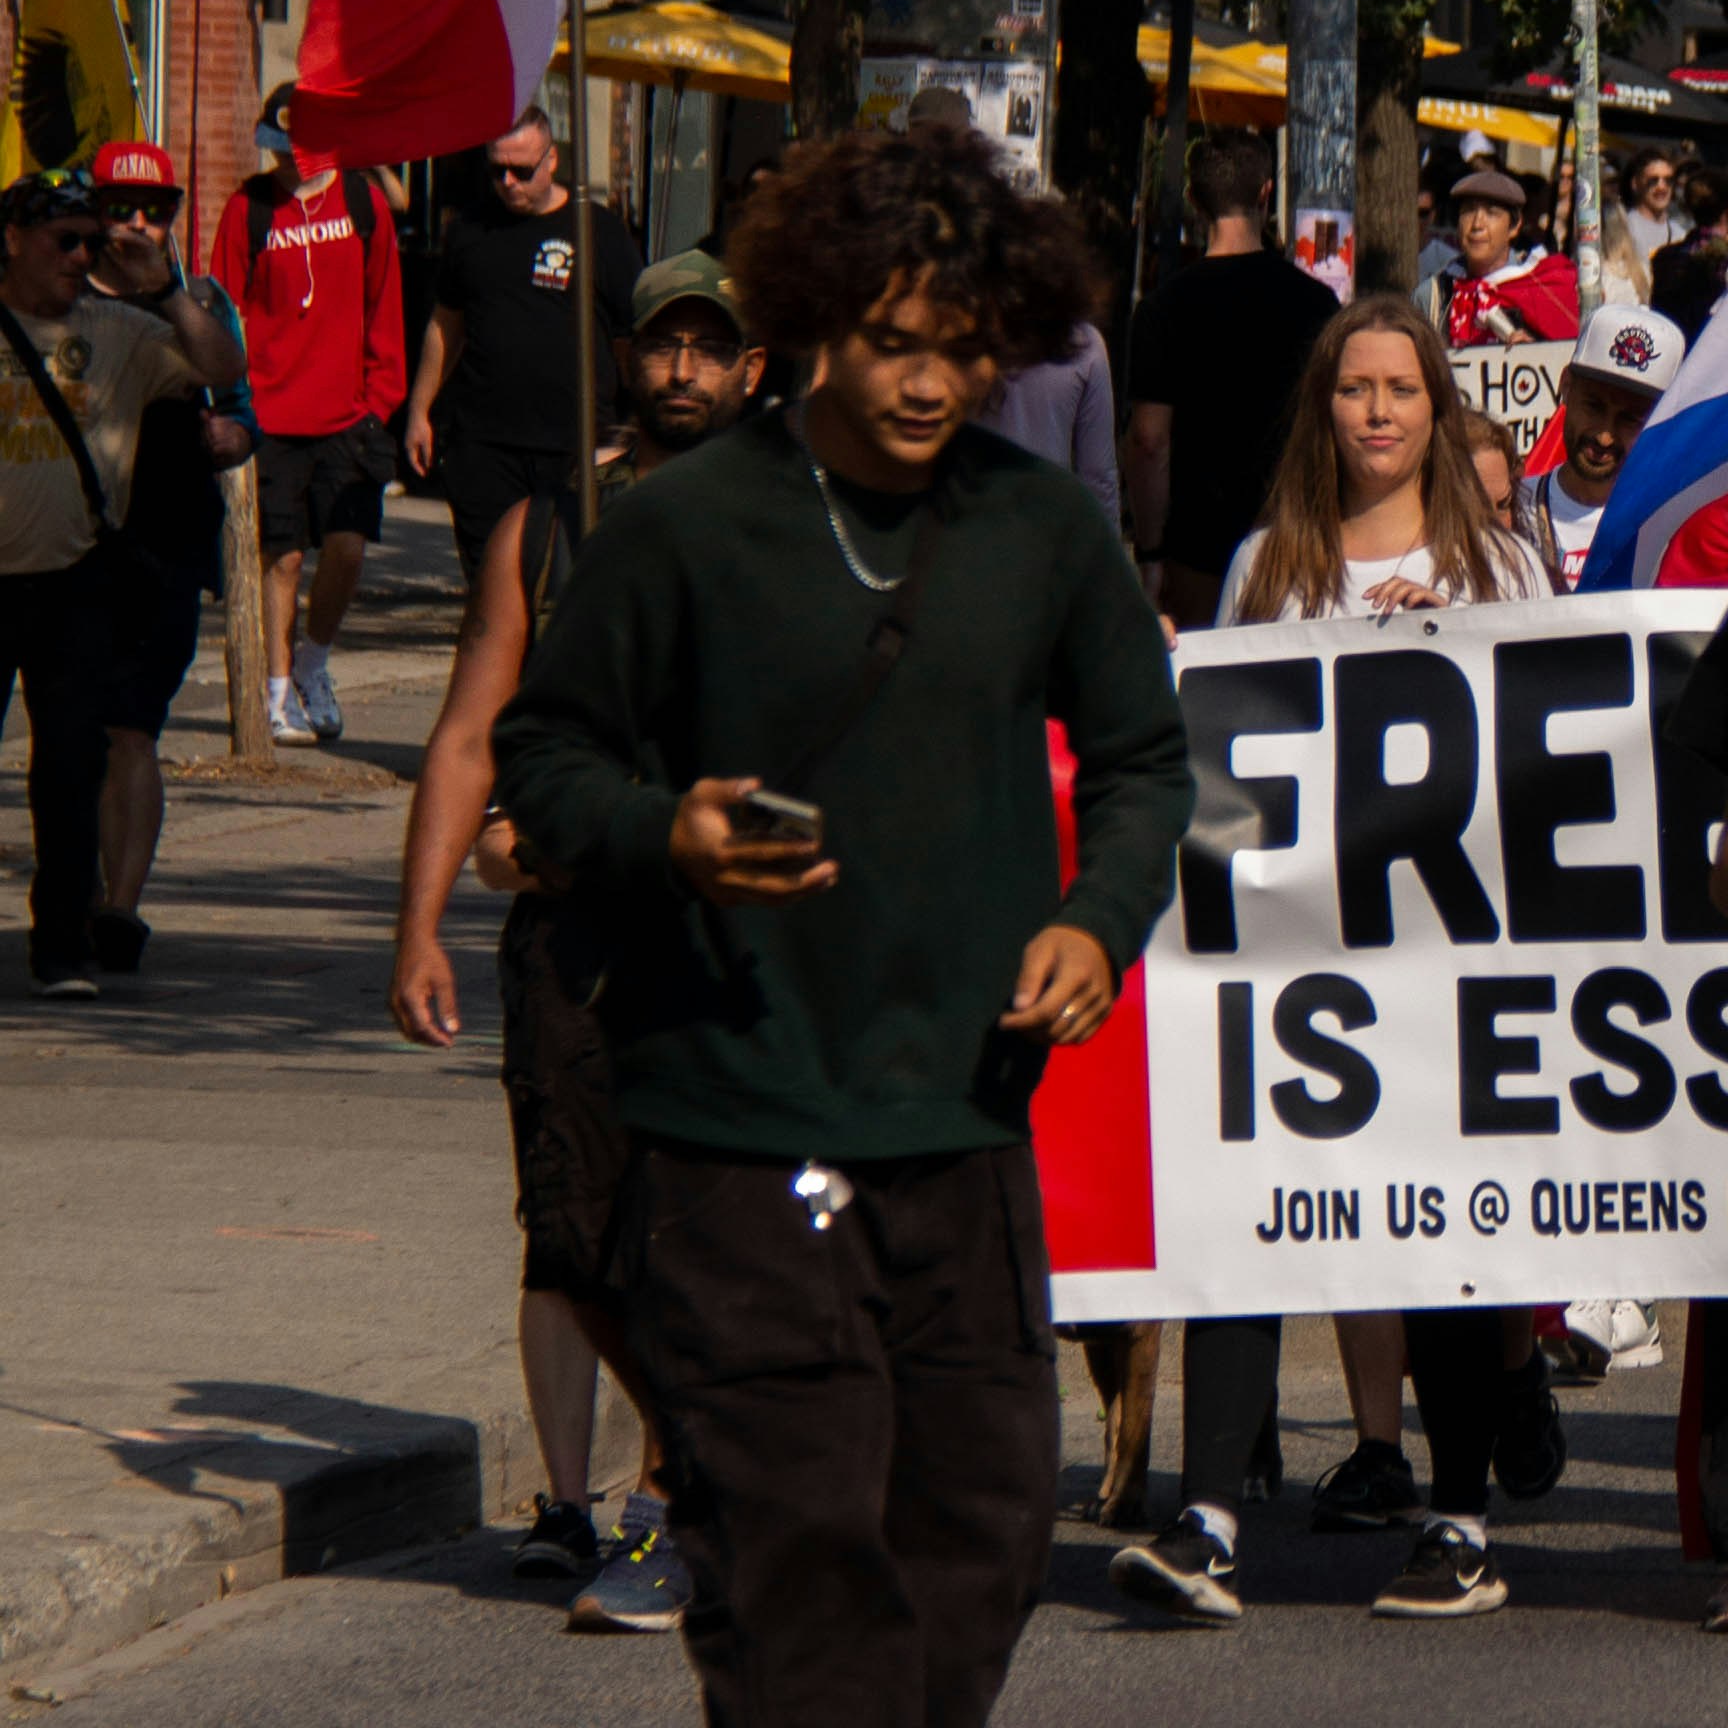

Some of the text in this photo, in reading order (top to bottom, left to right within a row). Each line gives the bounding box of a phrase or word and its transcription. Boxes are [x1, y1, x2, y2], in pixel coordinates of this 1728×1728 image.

[112, 152, 162, 183] CANADA
[266, 215, 354, 251] TANFORD
[1218, 972, 1381, 1142] IS
[1256, 1187, 1360, 1243] JOIN
[1386, 1183, 1447, 1240] US
[1468, 1179, 1510, 1237] @
[1531, 1178, 1707, 1239] QUEENS
